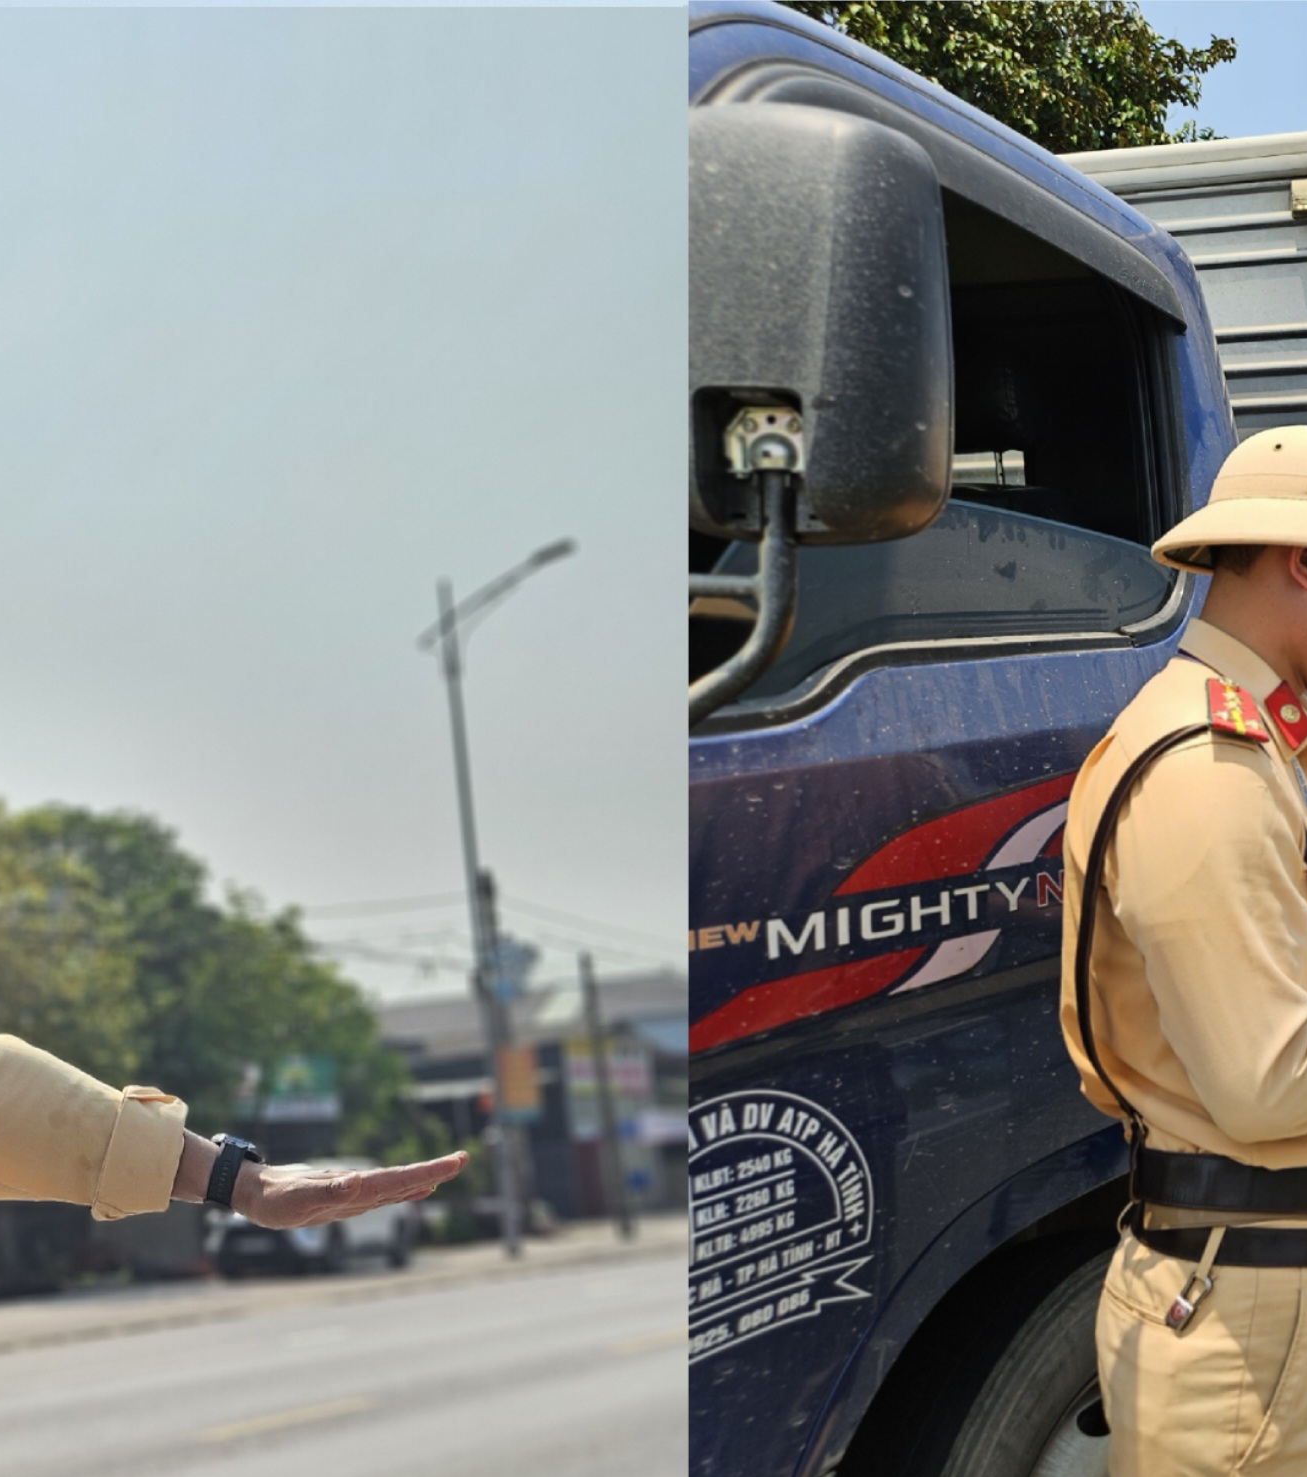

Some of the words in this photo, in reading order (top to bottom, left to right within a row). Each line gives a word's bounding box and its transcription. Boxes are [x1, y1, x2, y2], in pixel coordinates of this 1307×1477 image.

[689, 920, 761, 952] EW
[765, 876, 1031, 961] MIGHTY
[700, 1102, 737, 1142] VÀ
[742, 1102, 775, 1130] DV
[776, 1106, 822, 1142] ATP
[774, 1147, 793, 1169] KG
[776, 1178, 795, 1201] KG
[776, 1210, 795, 1232] KG
